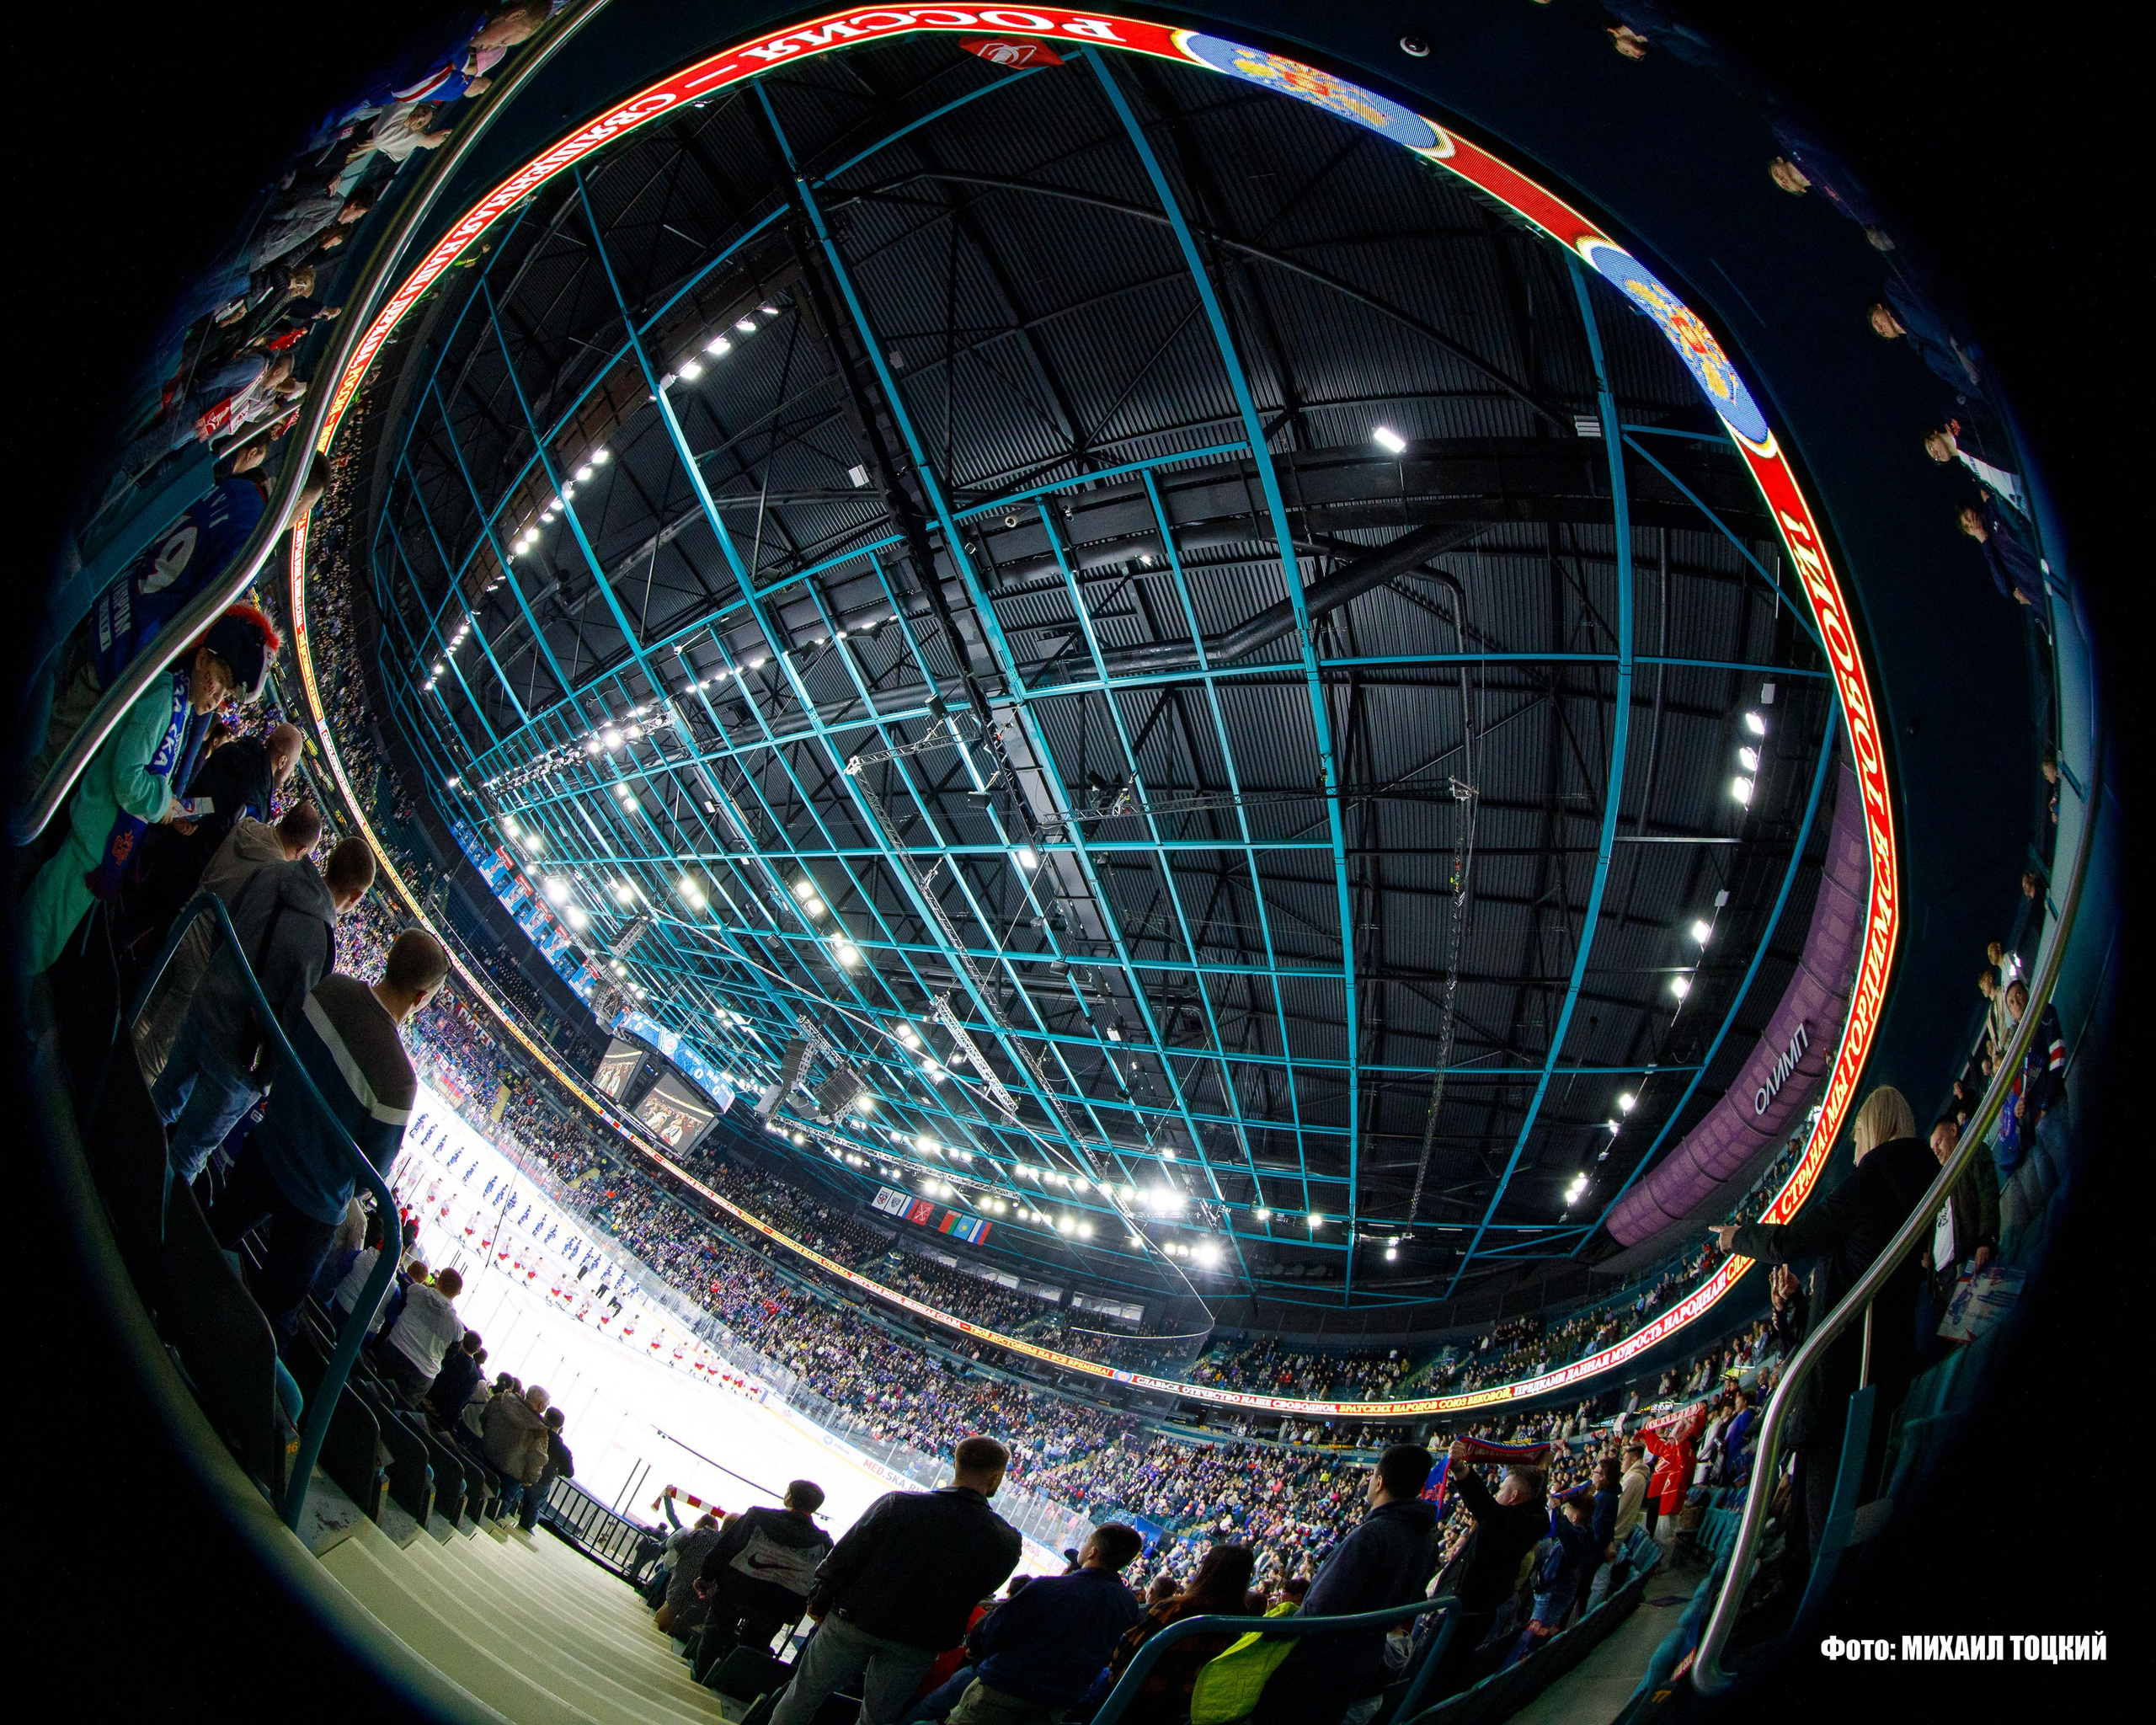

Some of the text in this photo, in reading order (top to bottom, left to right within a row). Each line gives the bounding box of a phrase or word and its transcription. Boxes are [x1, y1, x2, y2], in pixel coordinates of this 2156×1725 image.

[738, 8, 1129, 69] РОССИЯ
[452, 84, 678, 246] СВЯЩЕННАЯ
[398, 229, 468, 304] НАША
[350, 290, 414, 374] ДЕРЖАВА,
[1779, 503, 1885, 817] ТОБОЙ!
[1838, 813, 1892, 1078] ГОРДИМСЯ
[691, 1066, 706, 1081] 0
[709, 1084, 722, 1097] 0
[1754, 1023, 1809, 1115] ОЛИМП
[1820, 1069, 1854, 1132] МЫ
[1775, 1122, 1833, 1215] СТРАНА!
[632, 1136, 656, 1157] РОССИЯ
[660, 1158, 696, 1186] СВЯЩЕННАЯ
[693, 1182, 712, 1198] НАША
[710, 1194, 742, 1216] ДЕРЖАВА,
[739, 1212, 766, 1231] РОССИЯ
[770, 1231, 803, 1252] ЛЮБИМАЯ
[802, 1248, 824, 1263] НАША
[822, 1259, 851, 1278] СТРАНА.
[850, 1274, 883, 1294] МОГУЧАЯ
[882, 1289, 904, 1303] ВОЛЯ,
[903, 1299, 937, 1317] ВЕЛИКАЯ
[936, 1312, 962, 1327] СЛАВА
[969, 1326, 990, 1338] ТВОЁ
[989, 1332, 1038, 1355] ДОСТОЯНЬЕ
[1038, 1349, 1051, 1359] НА
[1050, 1354, 1068, 1364] ВСЕ
[1067, 1359, 1110, 1375] ВРЕМЕНА!
[1658, 1270, 1733, 1333] НАРОДНАЯ!
[1607, 1323, 1666, 1365] МУДРОСТЬ
[1135, 1376, 1181, 1392] СЛАВЬСЯ,
[1512, 1371, 1569, 1397] ПРЕДКАМИ
[1562, 1353, 1614, 1383] ДАННАЯ
[1182, 1386, 1241, 1403] ОТЕЧЕСТВО
[1241, 1396, 1272, 1407] НАШЕ
[1273, 1399, 1338, 1413] СВОБОДНОЕ,
[1338, 1405, 1391, 1413] БРАТСКИХ
[1392, 1401, 1438, 1413] НАРОДОВ
[1438, 1397, 1468, 1409] СОЮЗ
[1466, 1387, 1513, 1406] ВЕКОВОЙ,
